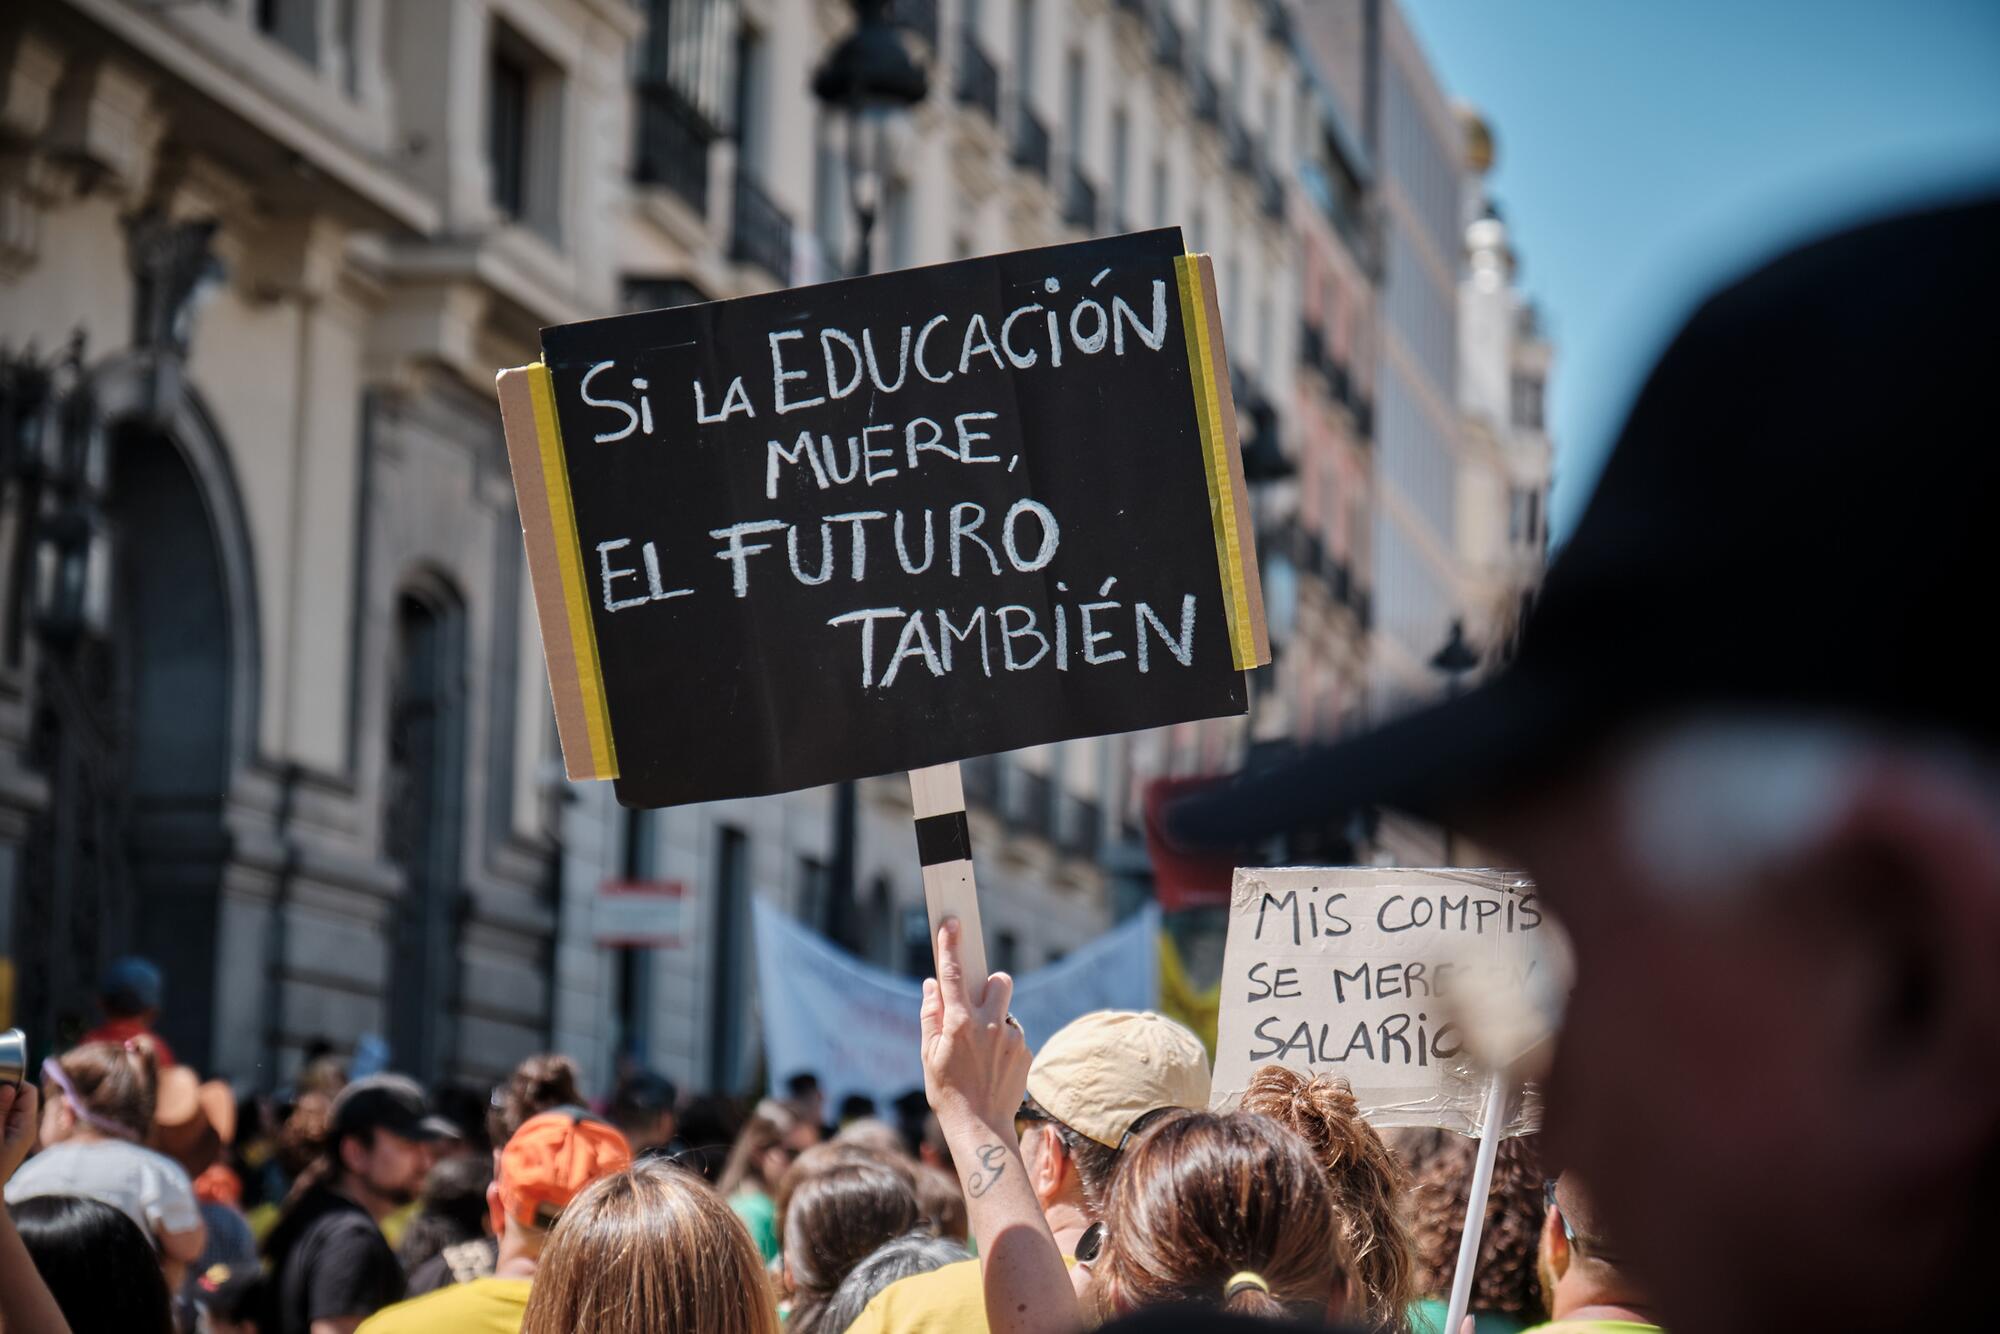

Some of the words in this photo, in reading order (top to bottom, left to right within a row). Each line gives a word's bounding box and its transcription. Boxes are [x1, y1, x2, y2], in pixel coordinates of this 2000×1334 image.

[693, 376, 756, 424] LA
[766, 411, 1019, 500] MUERE,
[596, 538, 695, 613] EL
[709, 498, 1060, 598] FUTURO
[1247, 961, 1302, 1003] SE
